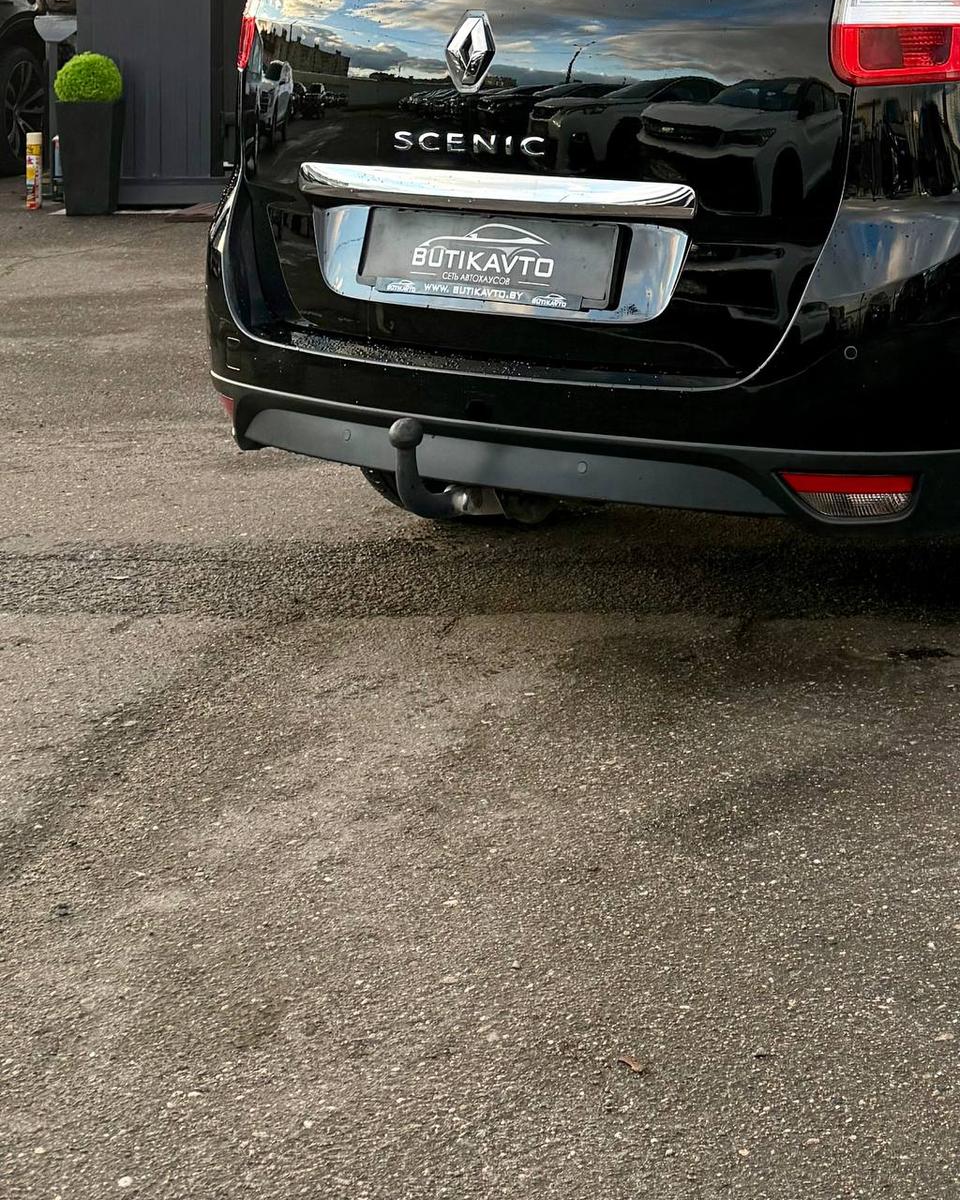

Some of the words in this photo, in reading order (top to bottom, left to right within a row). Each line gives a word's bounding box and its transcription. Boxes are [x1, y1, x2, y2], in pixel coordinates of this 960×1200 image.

[394, 131, 546, 155] SCENIC
[411, 247, 555, 278] BUTIKAVTO
[442, 271, 459, 281] СЕТЬ
[460, 273, 510, 285] АВТОХАУСОВ
[423, 282, 449, 293] WWW.
[452, 286, 524, 300] BUTIKAVTO.BY
